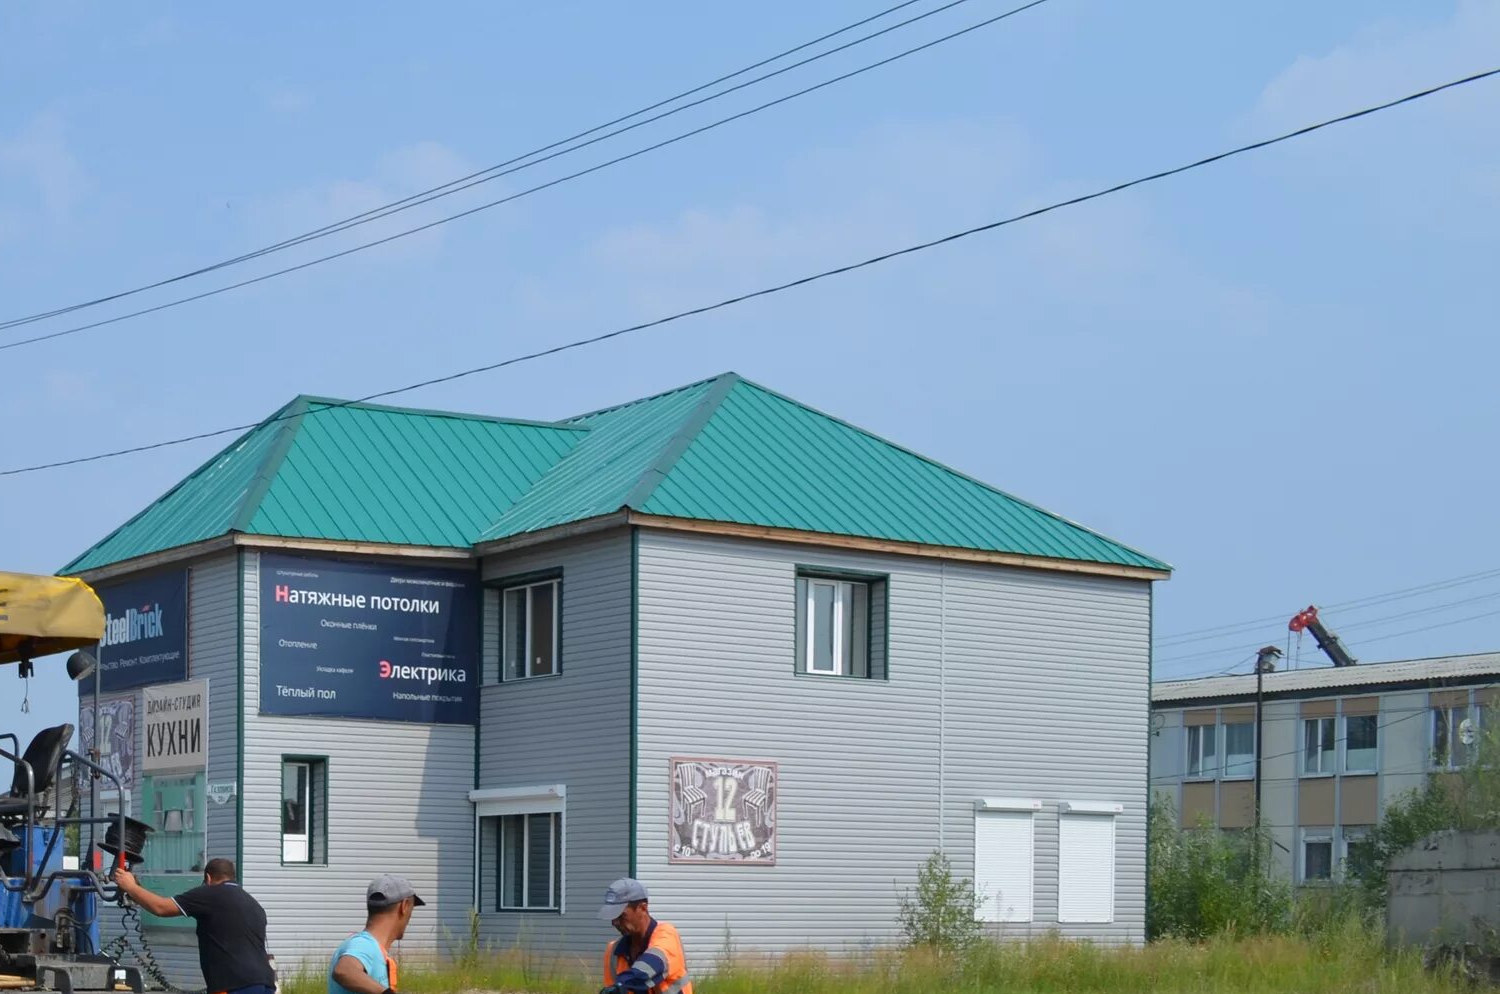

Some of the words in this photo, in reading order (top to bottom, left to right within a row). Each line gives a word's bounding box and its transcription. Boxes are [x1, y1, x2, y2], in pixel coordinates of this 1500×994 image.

[275, 585, 366, 609] Натяжные
[370, 595, 440, 614] потолки
[320, 619, 352, 629] Оконные
[352, 620, 378, 631] плёнки
[278, 638, 318, 649] Отопление
[379, 660, 467, 686] Электрика
[147, 694, 201, 714] ДИЗАЙН-СТУДИЯ
[276, 685, 315, 698] Тёплый
[317, 689, 336, 700] пол
[393, 691, 431, 701] Напольные
[147, 718, 201, 757] КУХНИ
[713, 776, 738, 821] 12
[691, 819, 756, 854] СТУЛЬЕВ
